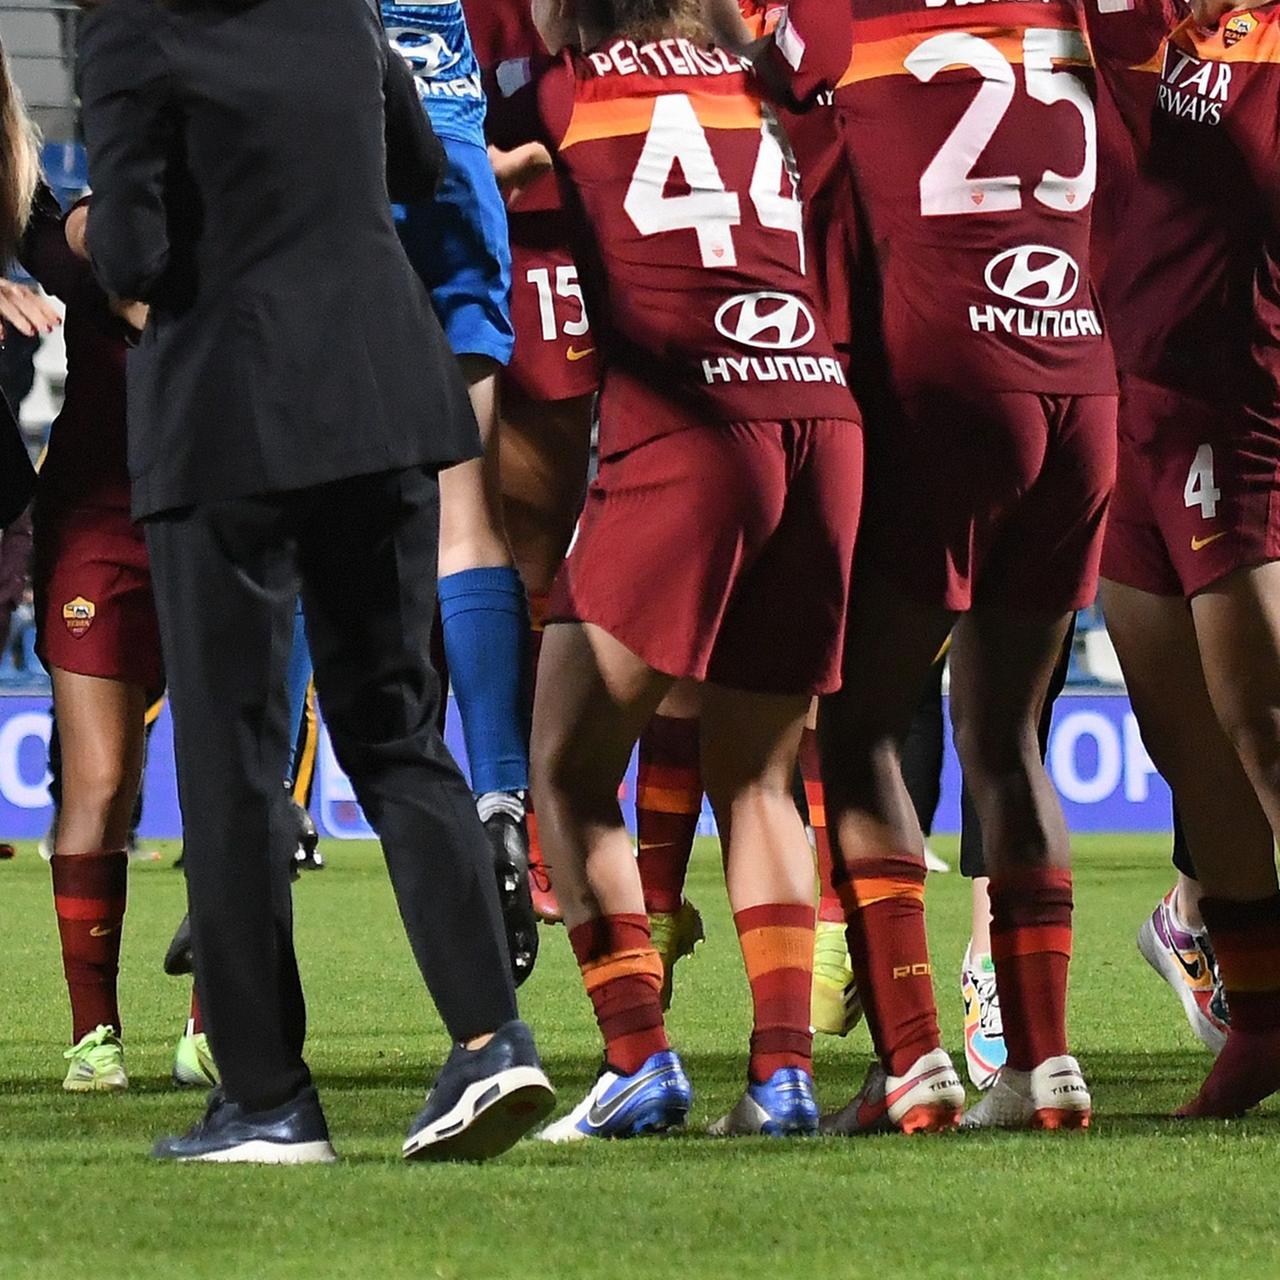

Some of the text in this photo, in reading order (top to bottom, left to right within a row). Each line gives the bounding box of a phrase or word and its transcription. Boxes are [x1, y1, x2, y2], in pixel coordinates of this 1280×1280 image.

[903, 28, 1097, 216] 25
[623, 94, 807, 276] 44
[527, 265, 590, 340] 15
[968, 305, 1102, 338] HYUNDAI
[702, 356, 847, 387] HYUNDAI
[1184, 445, 1221, 519] 4
